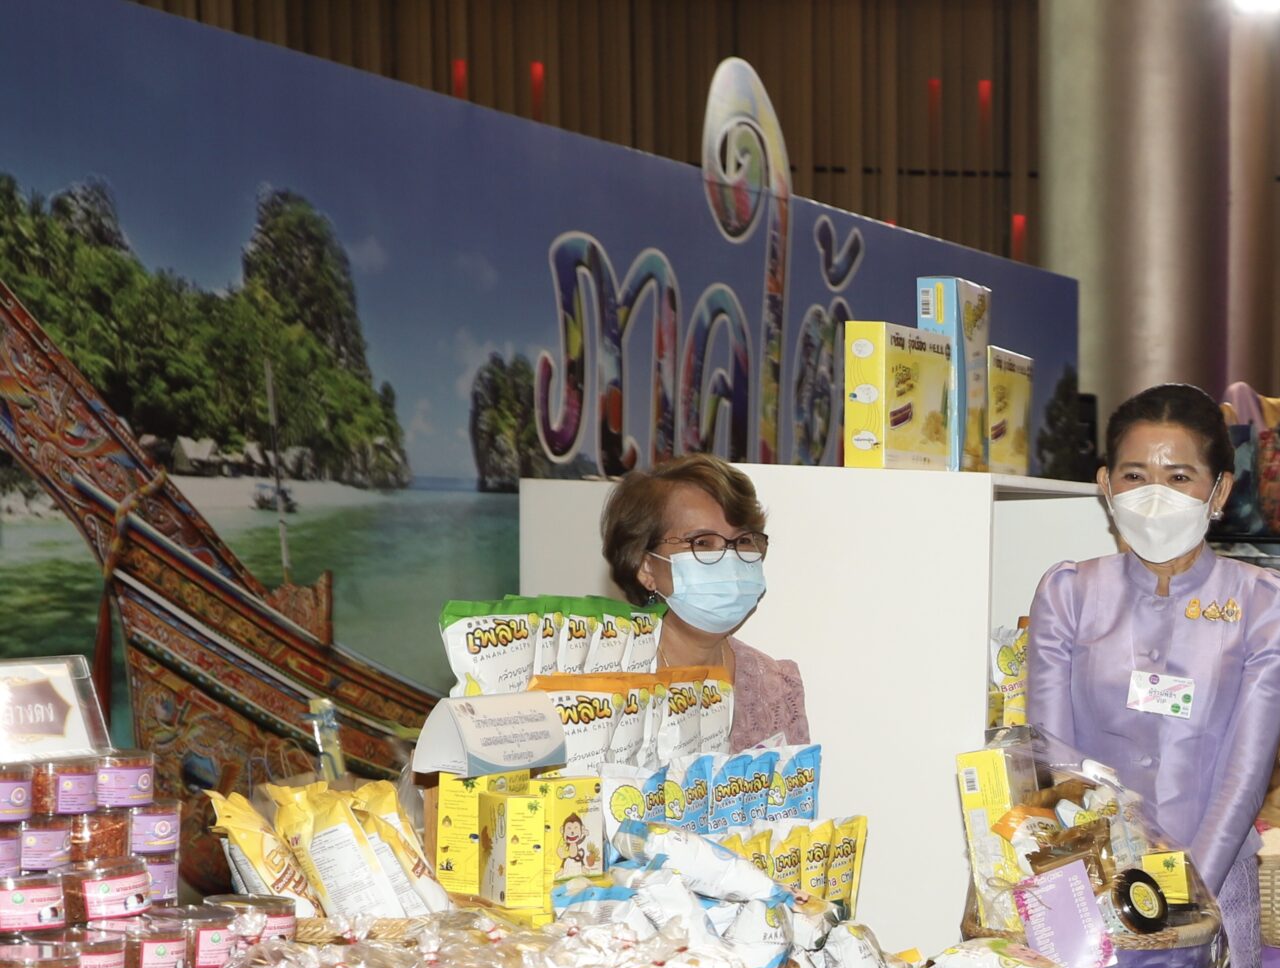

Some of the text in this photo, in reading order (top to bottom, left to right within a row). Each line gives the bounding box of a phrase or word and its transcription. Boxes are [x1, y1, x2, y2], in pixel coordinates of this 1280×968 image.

[466, 618, 529, 655] เพลิน
[473, 650, 507, 664] BANANA
[555, 695, 613, 725] พลิน
[565, 727, 589, 737] NANA
[767, 807, 798, 821] anana
